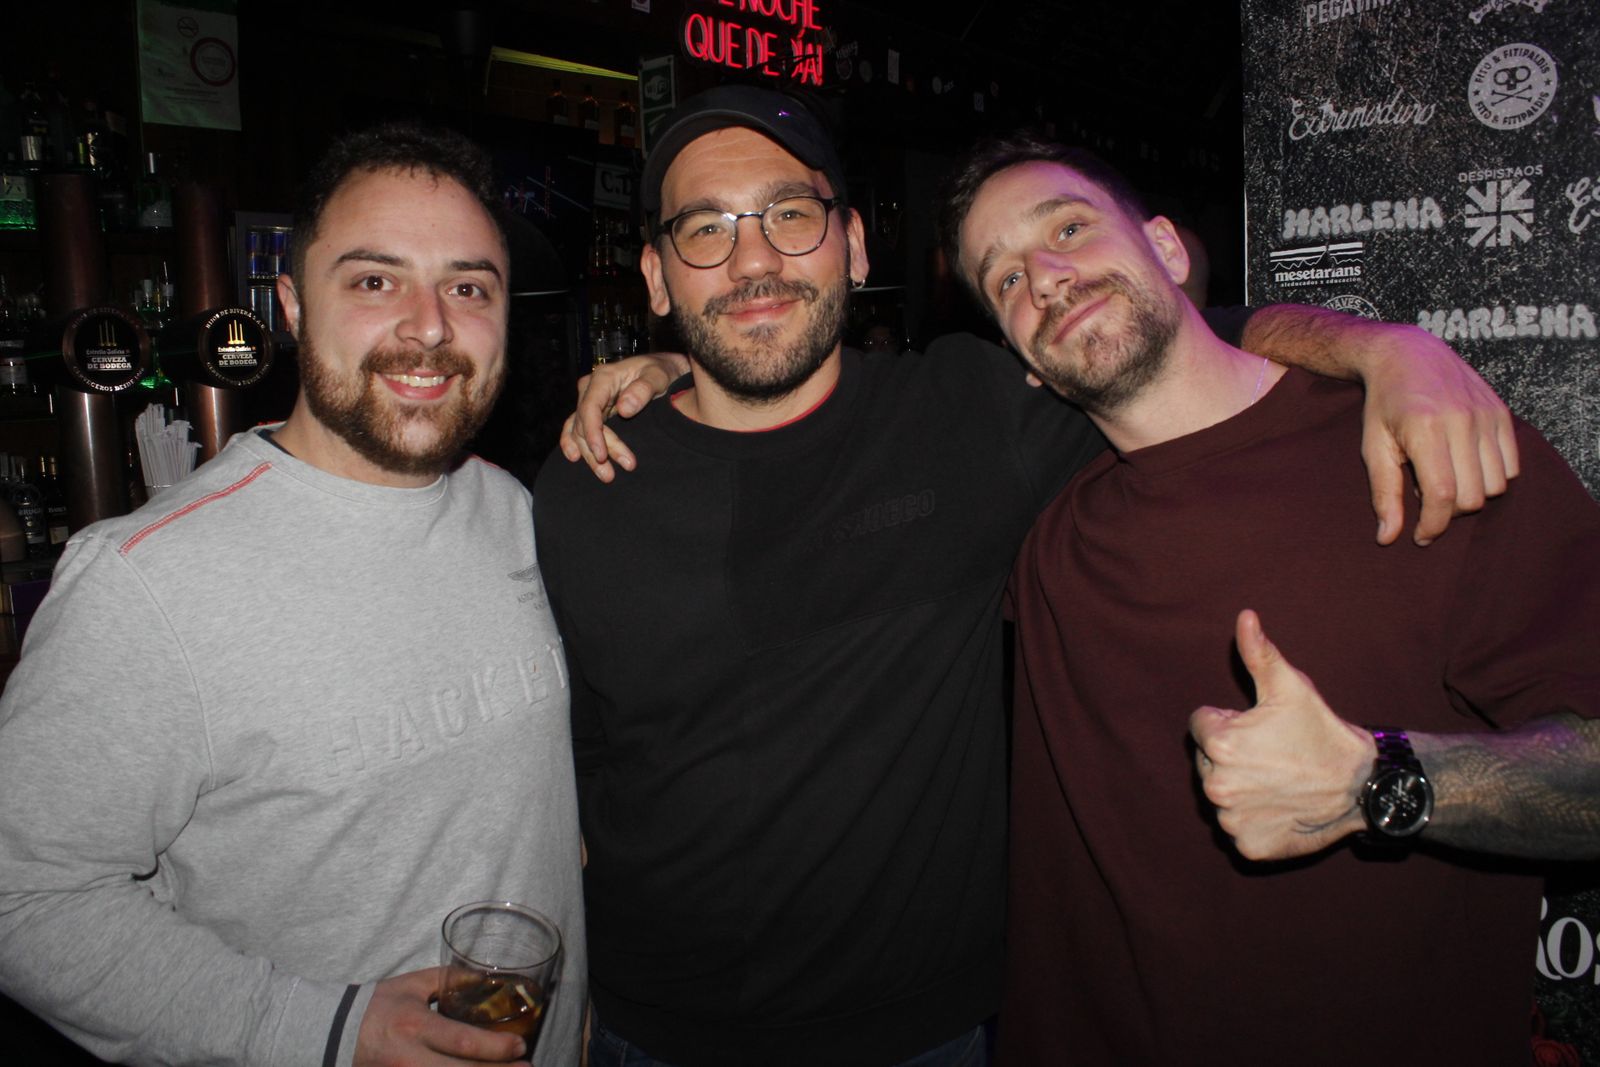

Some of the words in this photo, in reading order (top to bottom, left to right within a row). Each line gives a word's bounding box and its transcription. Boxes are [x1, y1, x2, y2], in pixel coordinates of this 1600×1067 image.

[1475, 62, 1492, 83] FITO
[1503, 47, 1551, 74] FITIPALDIS
[1475, 101, 1492, 120] FITO
[1502, 91, 1550, 125] FITIPALDIS
[1458, 164, 1544, 183] DESPISTAOS
[1275, 265, 1361, 283] mesetarians
